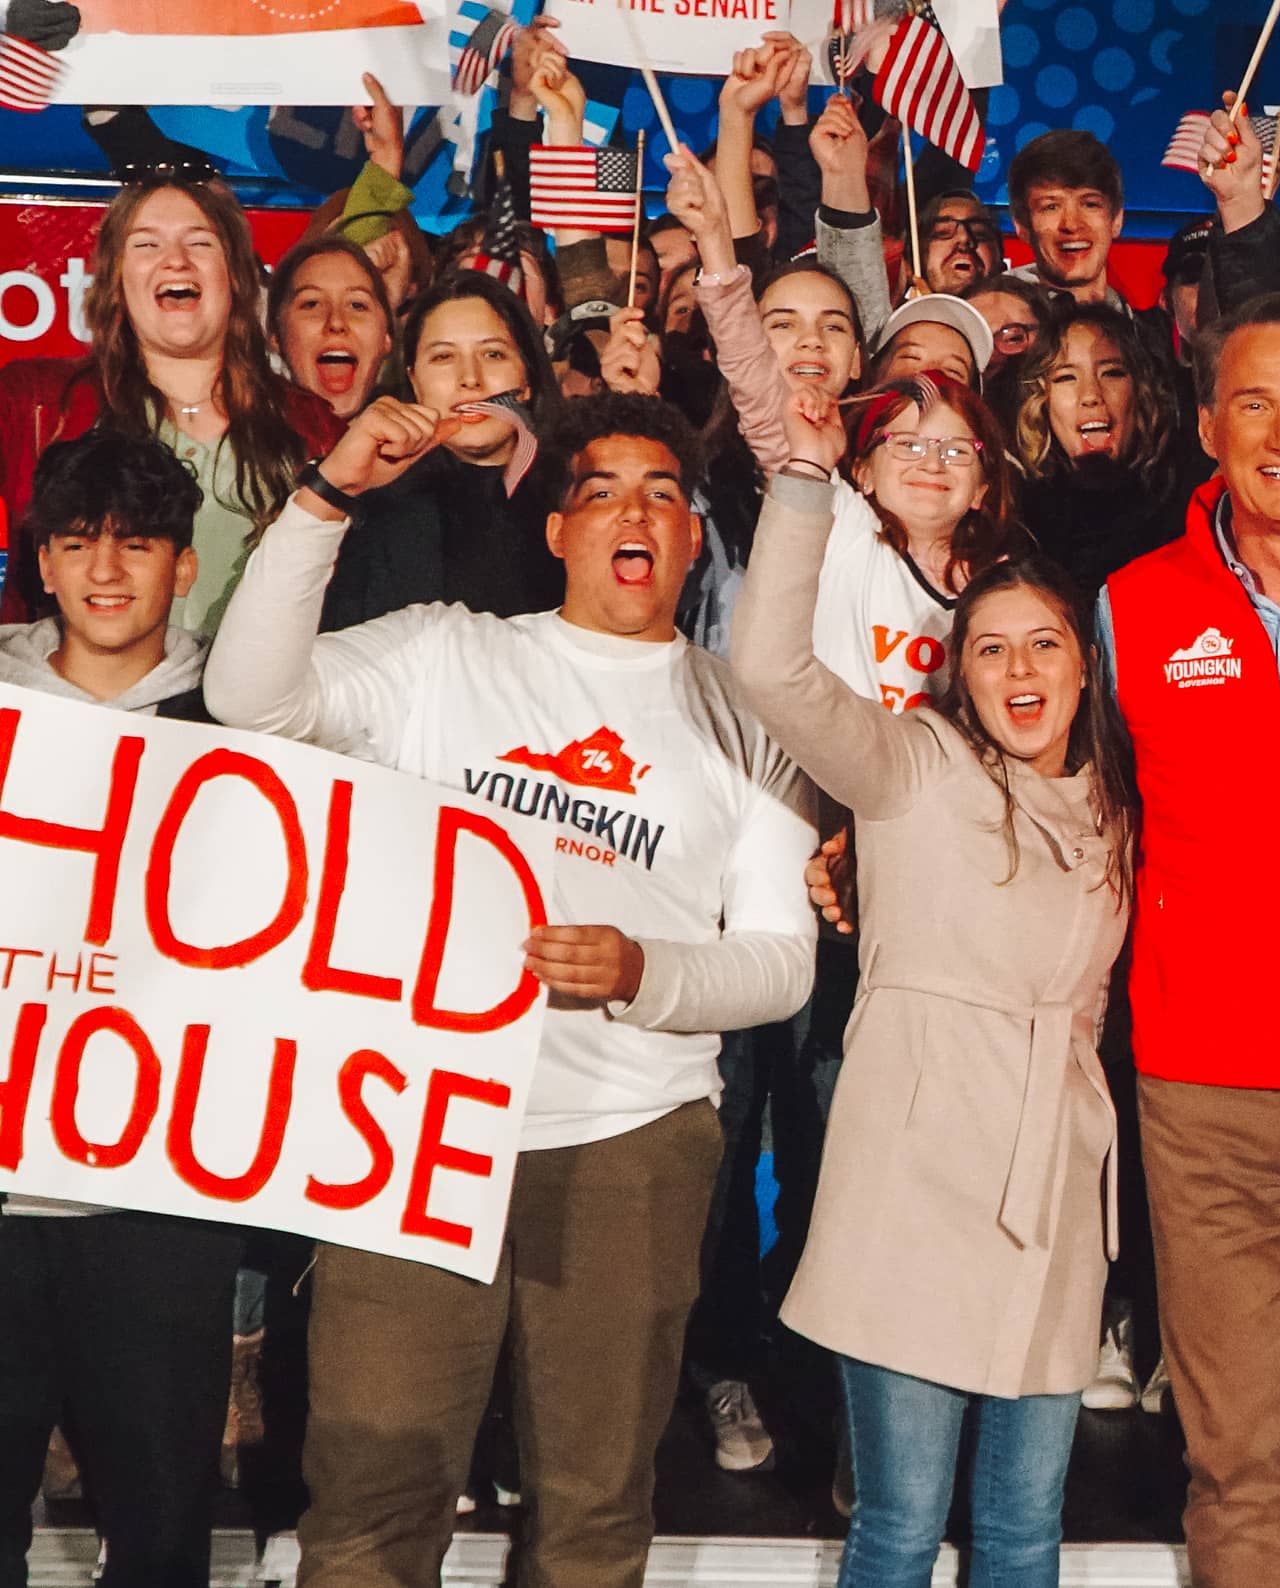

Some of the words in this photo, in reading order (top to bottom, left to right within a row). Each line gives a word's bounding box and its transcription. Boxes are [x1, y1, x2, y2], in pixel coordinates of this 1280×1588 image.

[674, 0, 778, 21] SENATE
[0, 257, 96, 343] ot
[872, 625, 946, 674] VO
[1163, 658, 1242, 684] YOUNGKIN
[1178, 677, 1225, 688] GOVERNOR
[581, 748, 614, 773] 74
[464, 768, 665, 871] YOUNGKIN
[0, 707, 547, 1034] HOLD
[555, 836, 617, 867] RNOR
[0, 947, 118, 994] THE
